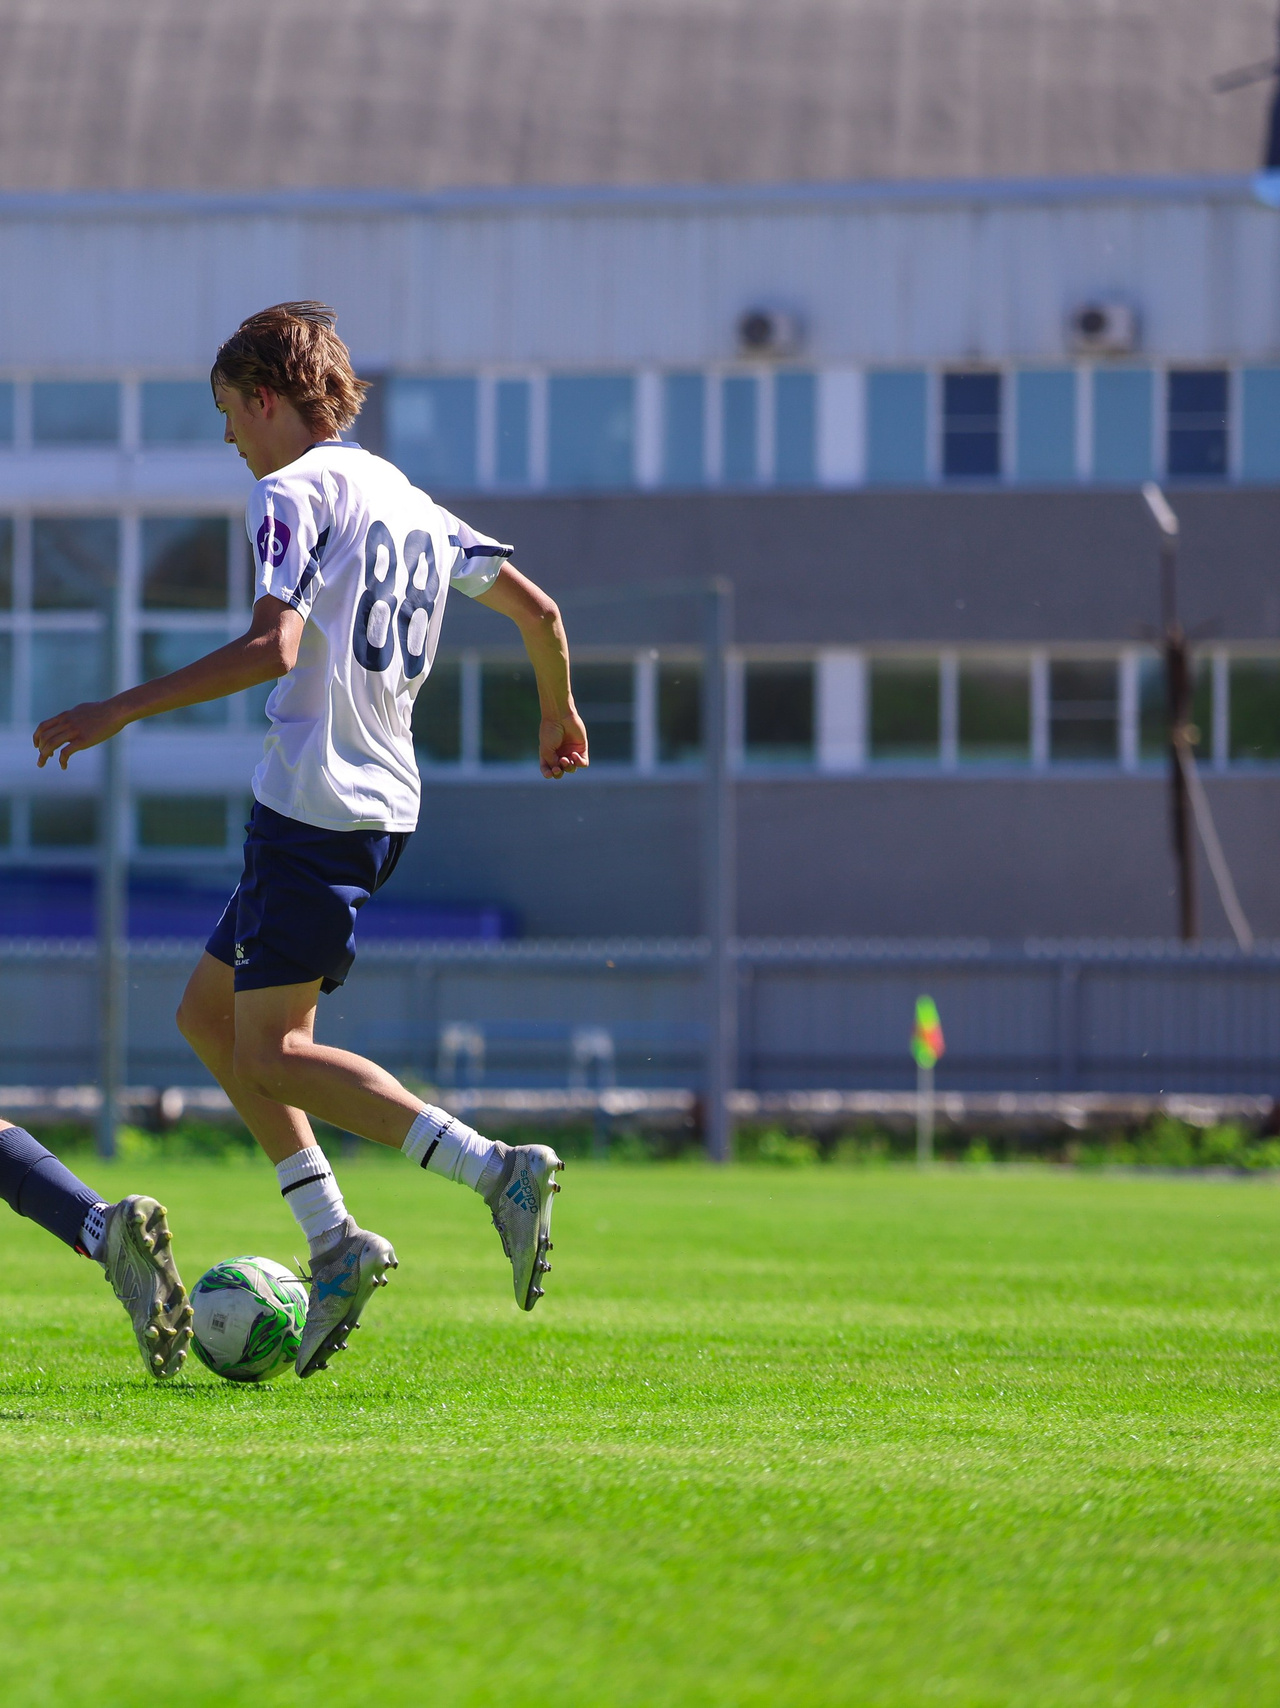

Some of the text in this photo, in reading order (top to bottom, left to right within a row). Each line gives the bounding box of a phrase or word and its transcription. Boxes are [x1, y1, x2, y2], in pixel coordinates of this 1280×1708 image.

[353, 520, 439, 679] 88
[436, 1117, 454, 1139] KEL
[520, 1169, 538, 1214] adidas
